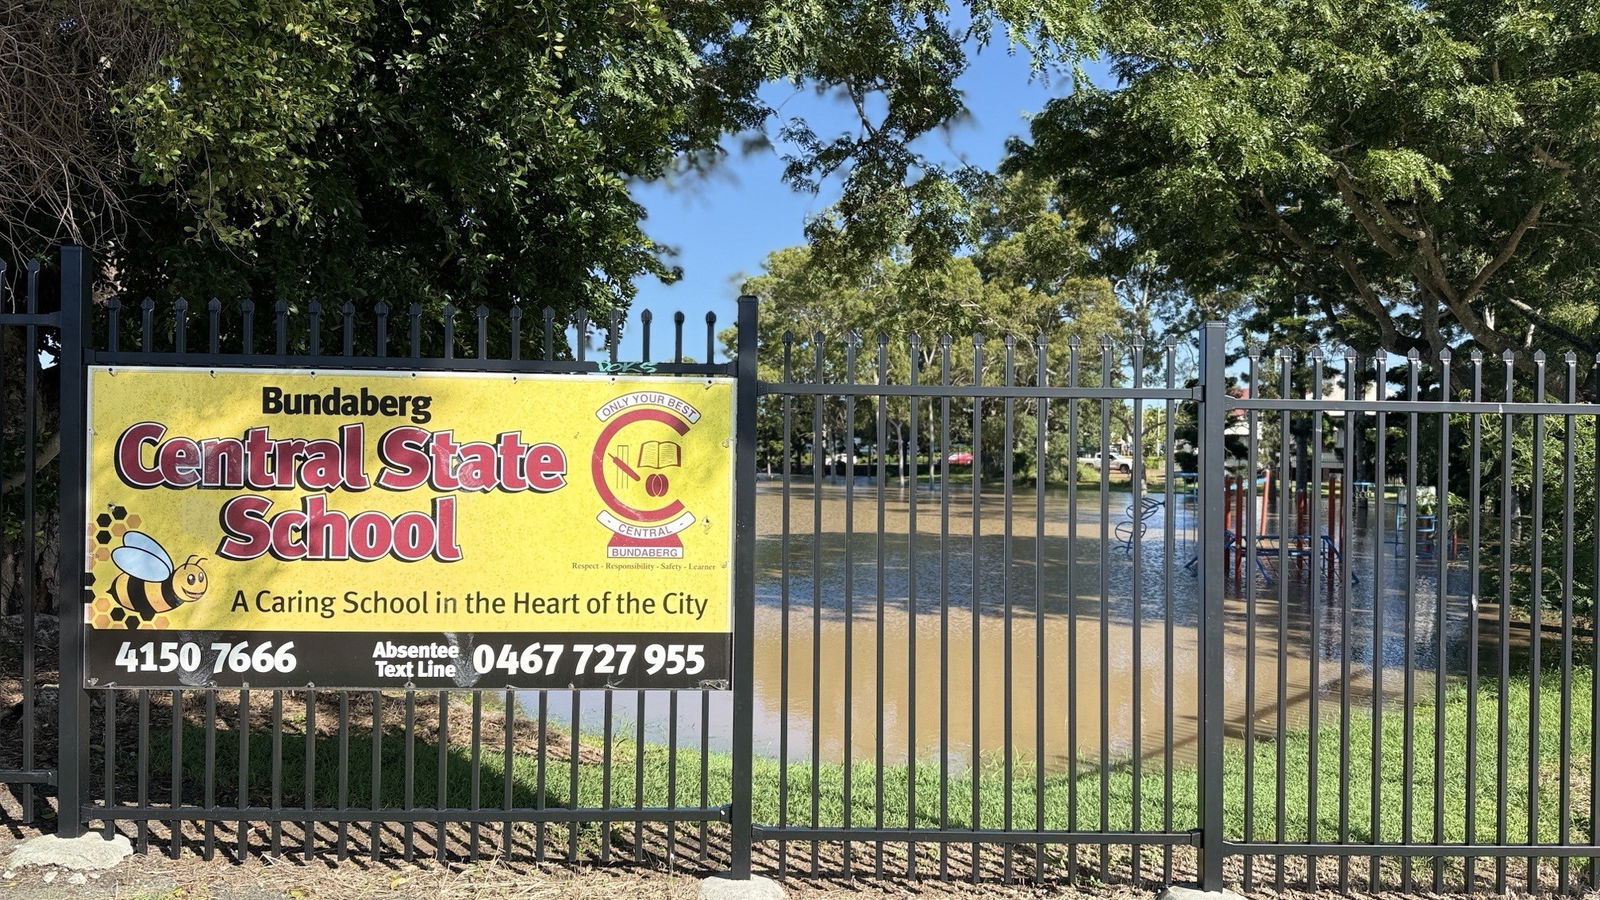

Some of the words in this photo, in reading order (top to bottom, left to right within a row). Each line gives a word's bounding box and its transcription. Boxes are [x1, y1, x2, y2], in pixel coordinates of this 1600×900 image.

[262, 387, 432, 424] Bundaberg
[602, 397, 629, 417] ONLY
[632, 394, 665, 404] YOUR
[667, 398, 696, 418] BEST
[114, 421, 371, 493] Central
[374, 426, 567, 493] State
[216, 494, 464, 562] School
[618, 523, 673, 538] CENTRAL
[612, 548, 678, 557] BUNDABERG
[572, 562, 599, 570] Respect
[606, 563, 654, 571] Responsibility
[661, 563, 682, 571] Safety
[689, 563, 716, 571] Learner
[231, 590, 249, 613] A
[255, 590, 335, 618] Caring
[343, 590, 429, 614] School
[436, 591, 457, 614] in
[465, 591, 506, 614] the
[513, 592, 580, 614] Heart
[586, 592, 611, 614] of
[616, 592, 656, 614] the
[662, 592, 708, 620] City
[115, 641, 200, 673] 4150
[210, 641, 297, 673] 7666
[372, 641, 459, 658] Absentee
[472, 642, 563, 675] 0467
[572, 643, 636, 675] 727
[644, 644, 705, 675] 955
[374, 661, 414, 677] Text
[417, 659, 456, 677] Line
